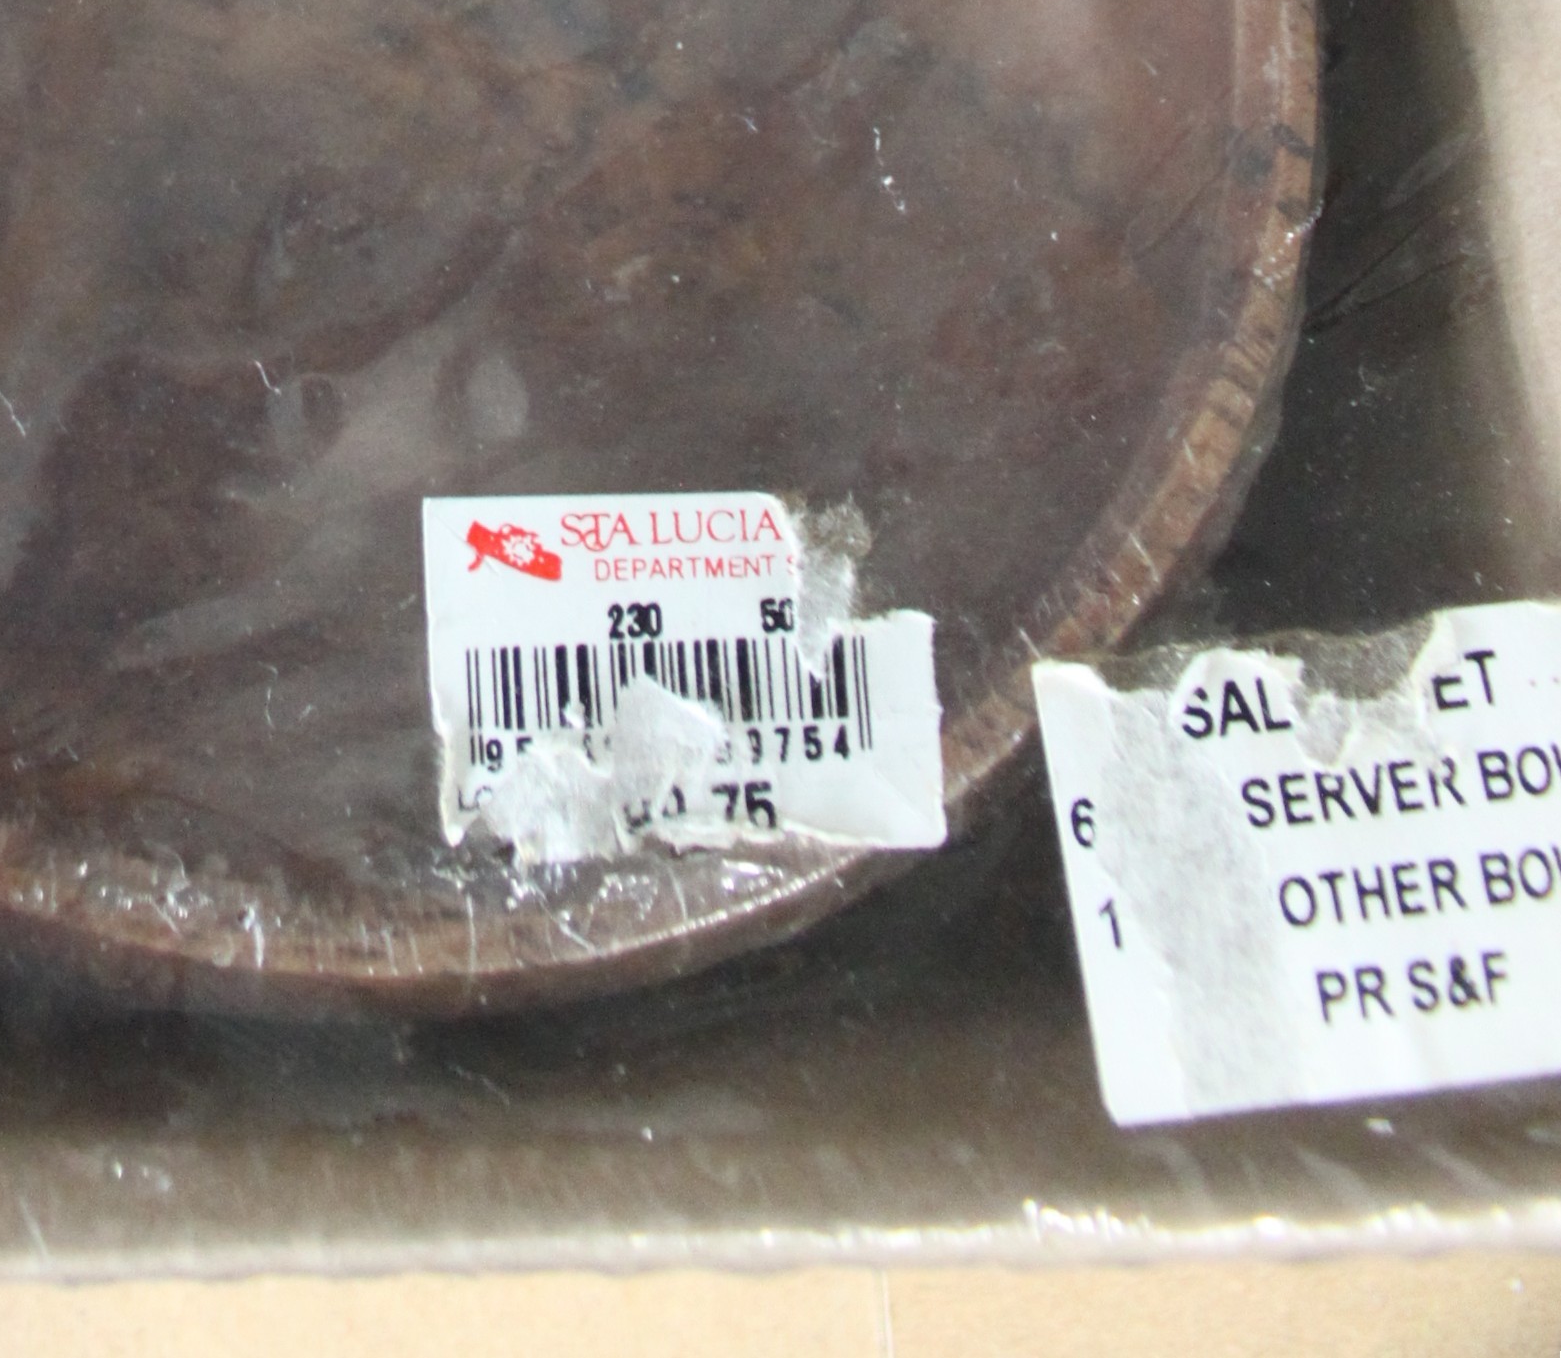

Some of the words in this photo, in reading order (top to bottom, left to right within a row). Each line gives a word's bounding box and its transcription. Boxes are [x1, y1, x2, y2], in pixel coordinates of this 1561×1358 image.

[649, 508, 783, 545] LUCIA
[594, 554, 775, 582] DEPARTMENT
[607, 602, 663, 639] 230
[1241, 756, 1467, 829] SERVER
[1278, 858, 1467, 928] OTHER
[1478, 845, 1561, 906] BO
[1315, 964, 1395, 1025] PR
[1405, 950, 1511, 1013] S&F
